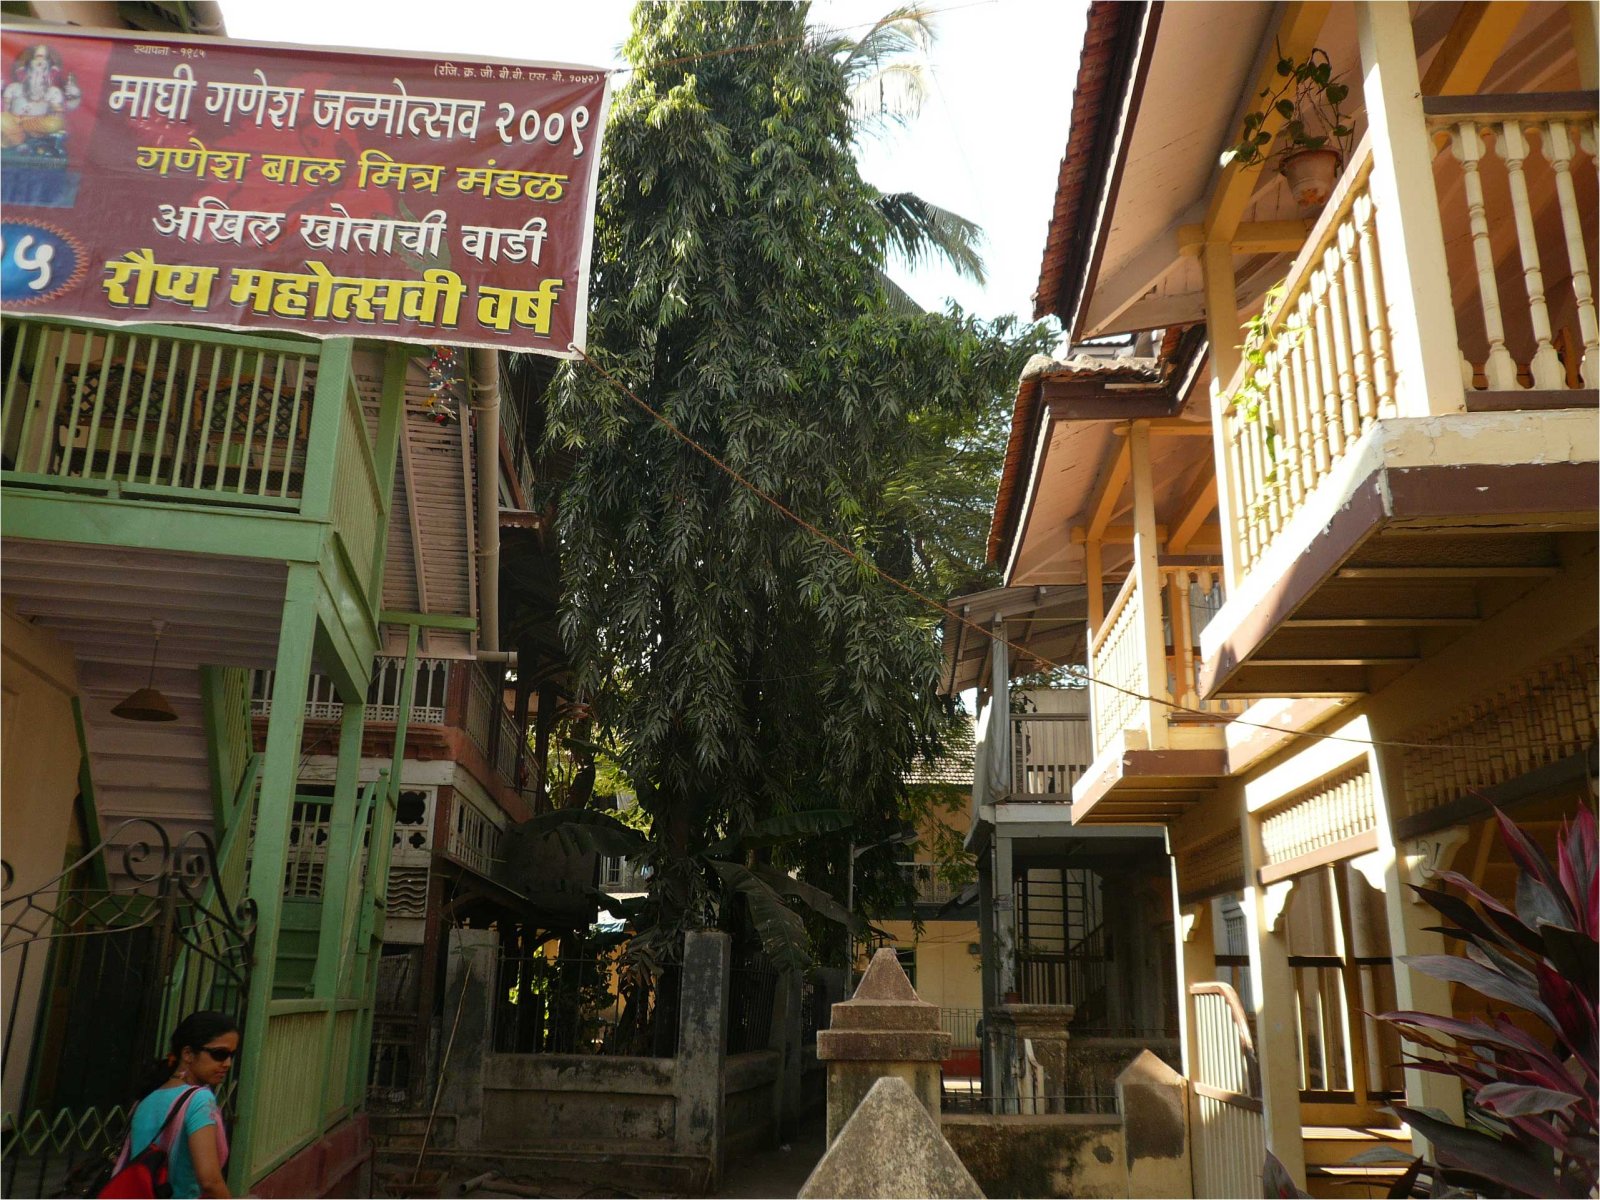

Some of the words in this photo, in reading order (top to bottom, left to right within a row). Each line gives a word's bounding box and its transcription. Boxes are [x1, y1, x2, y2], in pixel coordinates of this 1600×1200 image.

[133, 44, 170, 56] स्थापना
[108, 63, 197, 121] माघी
[205, 69, 305, 128] गणेश
[313, 78, 486, 139] जन्मोत्सव
[496, 102, 589, 156] २००९
[136, 137, 251, 181] गणेश
[261, 154, 346, 184] बाल
[357, 149, 446, 193] मित्र
[456, 159, 569, 201] मंडळ
[1, 234, 54, 290] ५
[152, 196, 286, 245] अखिल
[299, 202, 447, 258] खोताची
[460, 217, 548, 267] वाडी
[102, 248, 220, 309] रौप्य
[230, 260, 467, 327] महोत्सवी
[477, 279, 564, 335] वर्ष
